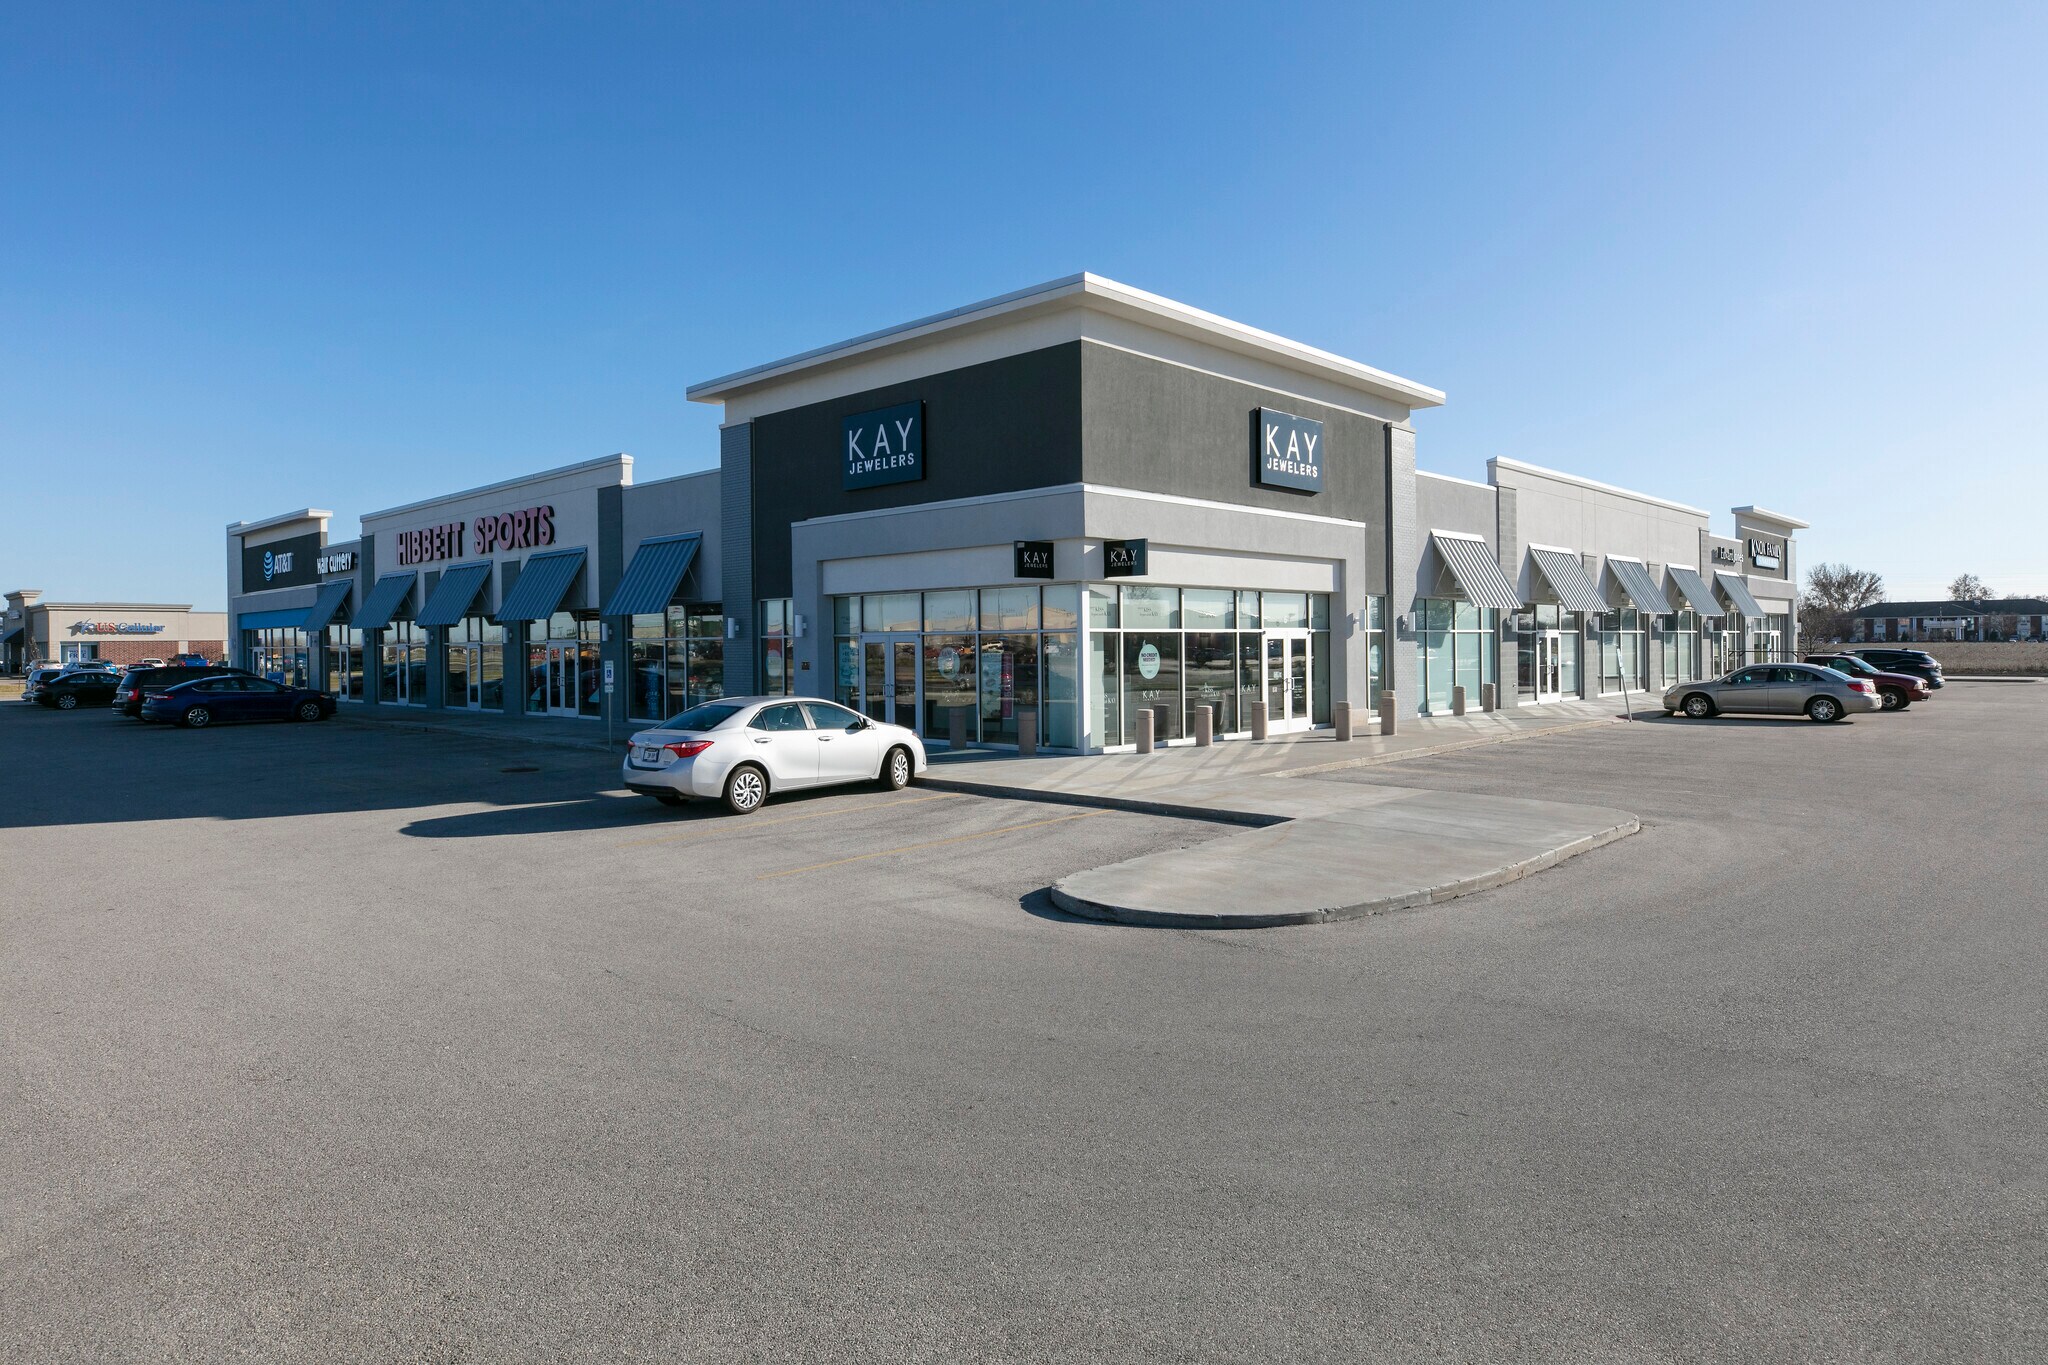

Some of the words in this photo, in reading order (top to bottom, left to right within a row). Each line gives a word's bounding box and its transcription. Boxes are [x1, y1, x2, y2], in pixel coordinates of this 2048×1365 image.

[848, 417, 914, 461] KAY
[1266, 423, 1318, 463] KAY
[849, 452, 915, 475] JEWELERS
[1266, 457, 1318, 478] JEWELERS
[397, 522, 463, 565] HIBBETT
[474, 505, 554, 554] SPORTS
[273, 552, 293, 575] AT&T
[1023, 551, 1048, 564] KAY
[1110, 549, 1138, 563] KAY
[1110, 560, 1138, 568] JEWELERS
[118, 622, 165, 633] Cellular
[1142, 689, 1161, 699] KAY
[1241, 683, 1258, 693] KAY
